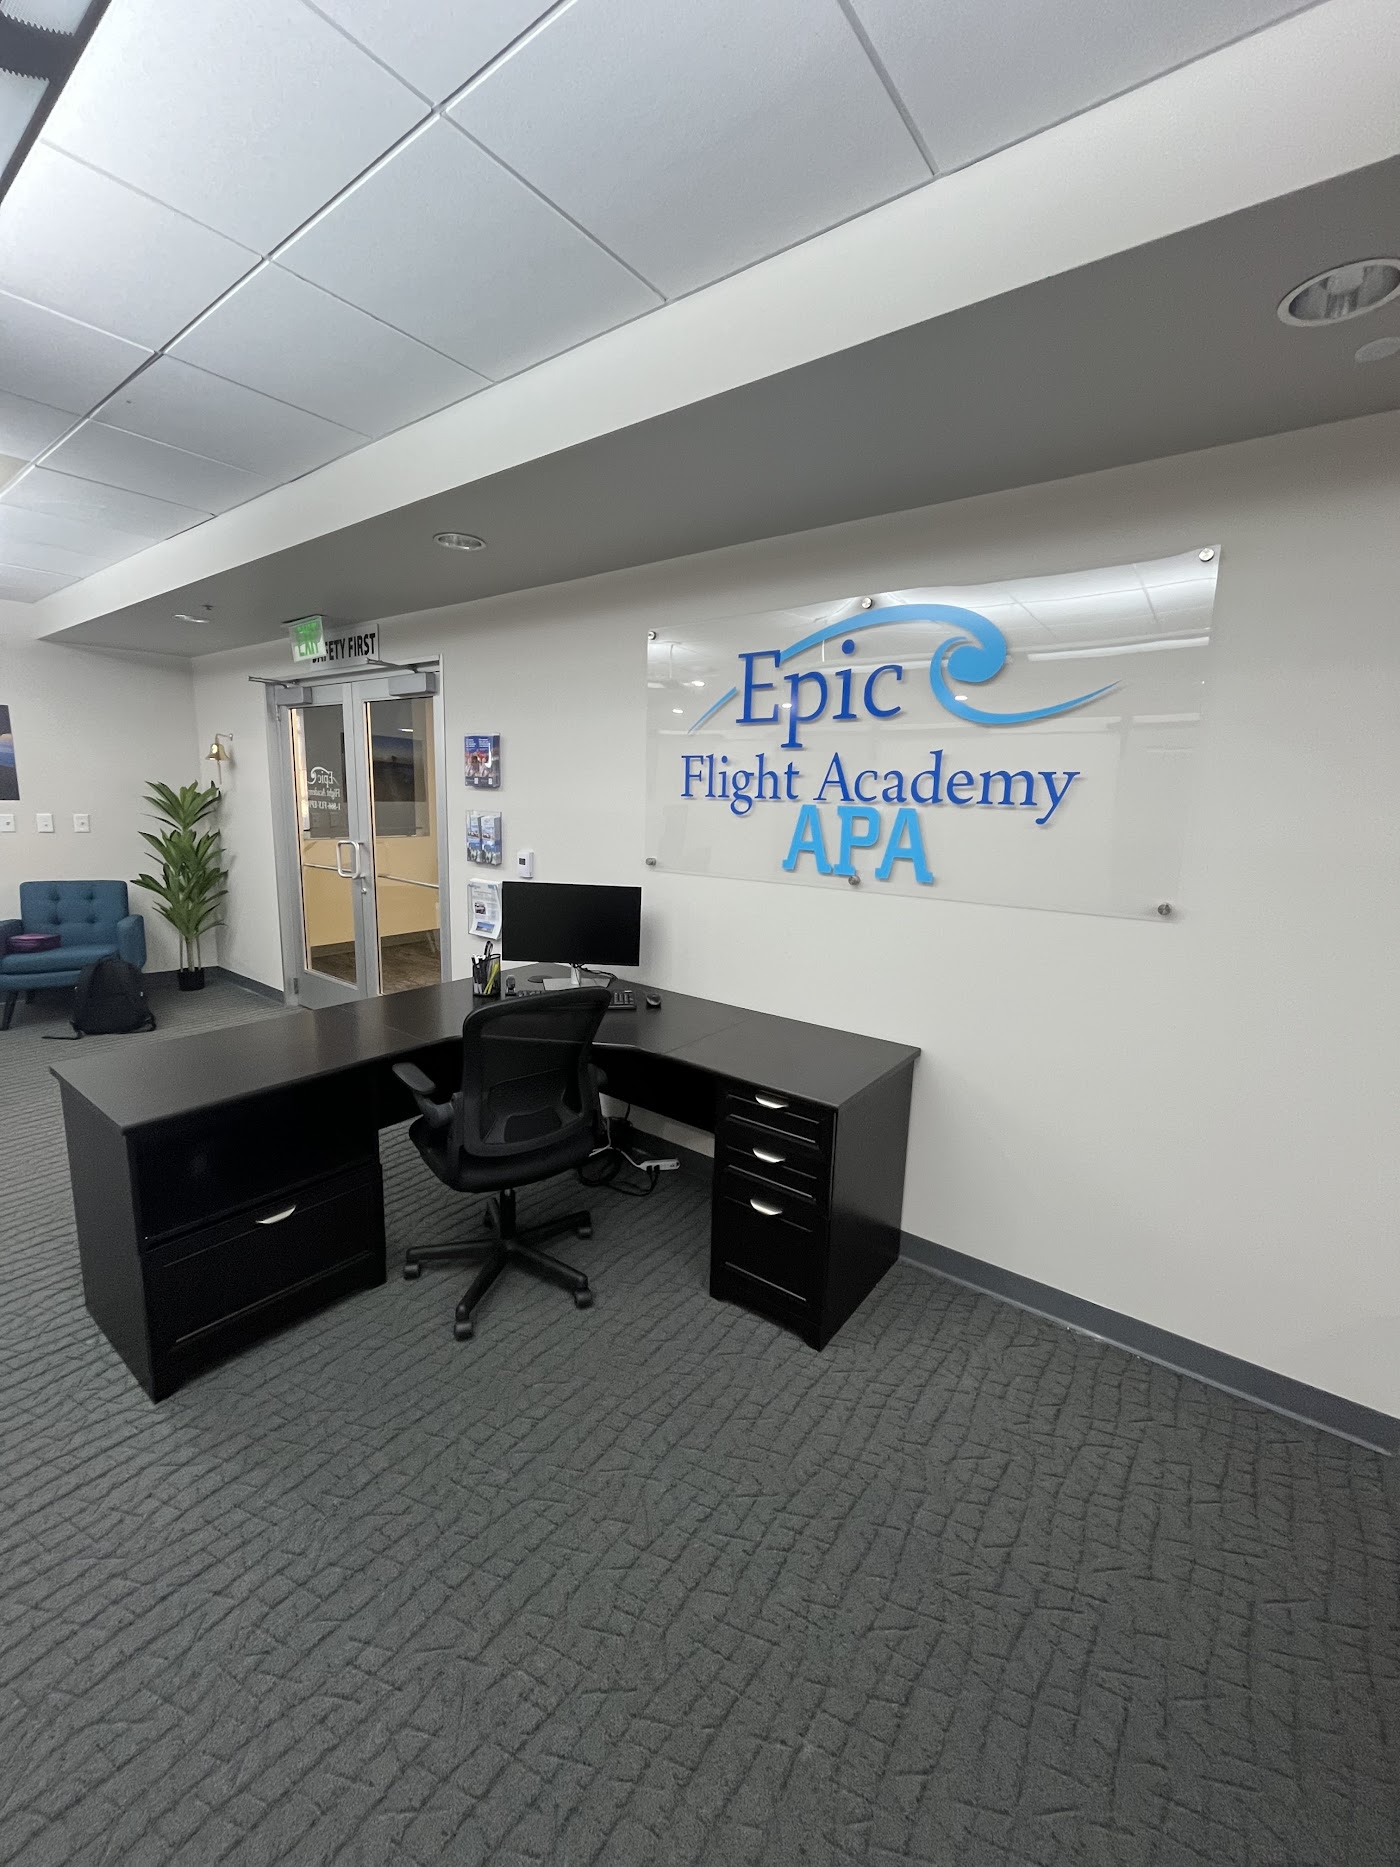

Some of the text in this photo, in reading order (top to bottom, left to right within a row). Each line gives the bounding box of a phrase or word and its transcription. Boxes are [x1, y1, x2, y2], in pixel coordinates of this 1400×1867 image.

[348, 633, 376, 658] FIRST
[736, 639, 903, 750] Epic
[681, 749, 1081, 826] Flight Academy
[781, 804, 935, 885] APA
